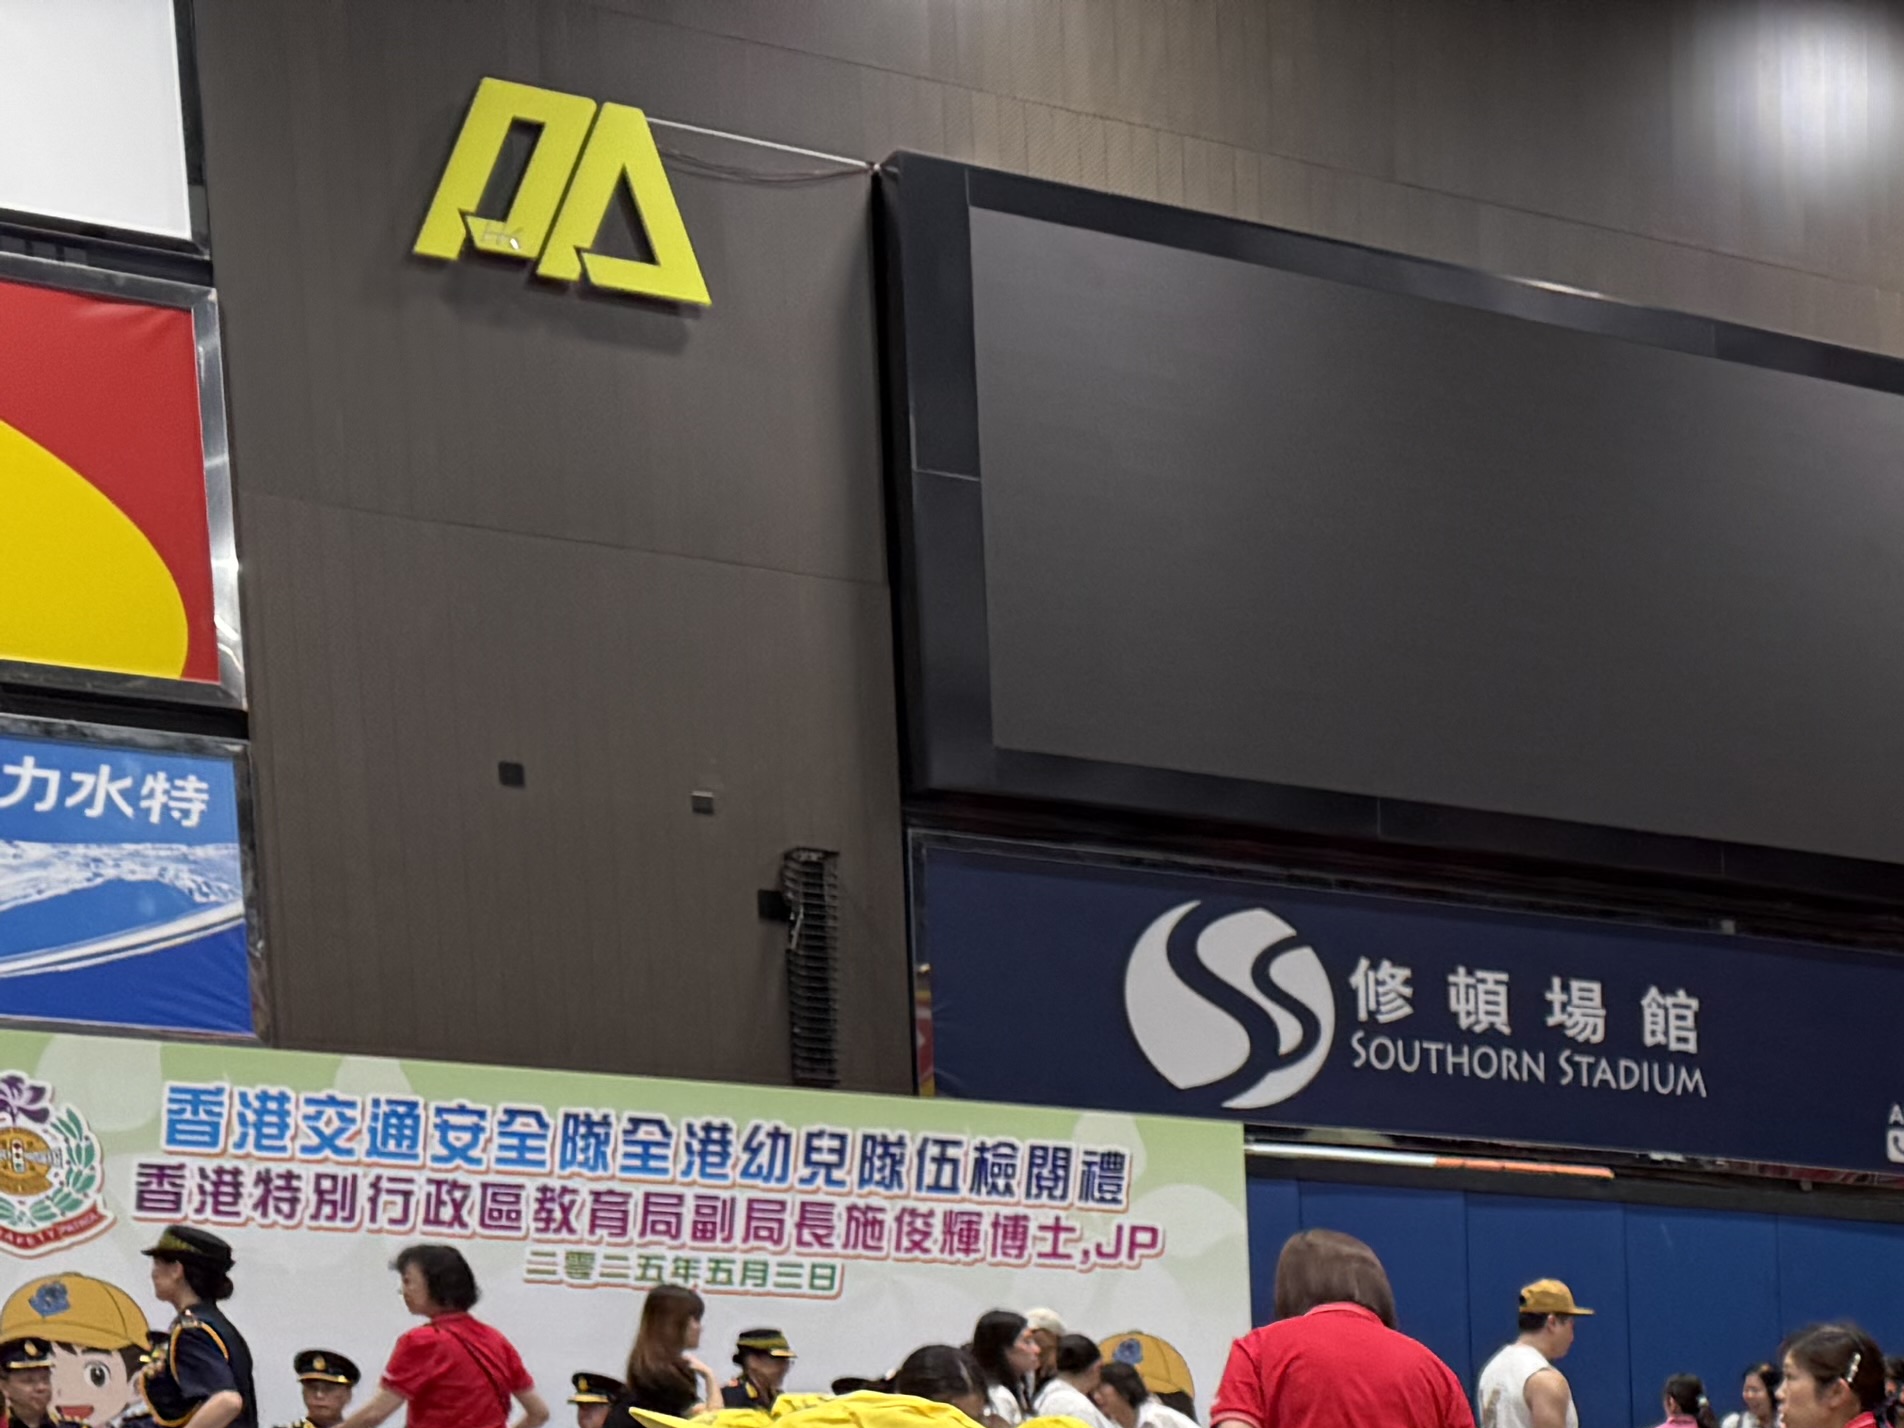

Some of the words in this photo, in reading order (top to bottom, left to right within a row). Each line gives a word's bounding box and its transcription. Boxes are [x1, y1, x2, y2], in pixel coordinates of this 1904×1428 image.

[0, 755, 210, 827] 力水特
[1349, 956, 1700, 1054] 修頓場館
[1350, 1030, 1546, 1084] SOUTHORN
[1557, 1049, 1707, 1098] STADIUM
[525, 1251, 837, 1291] 二零二五年五月三日
